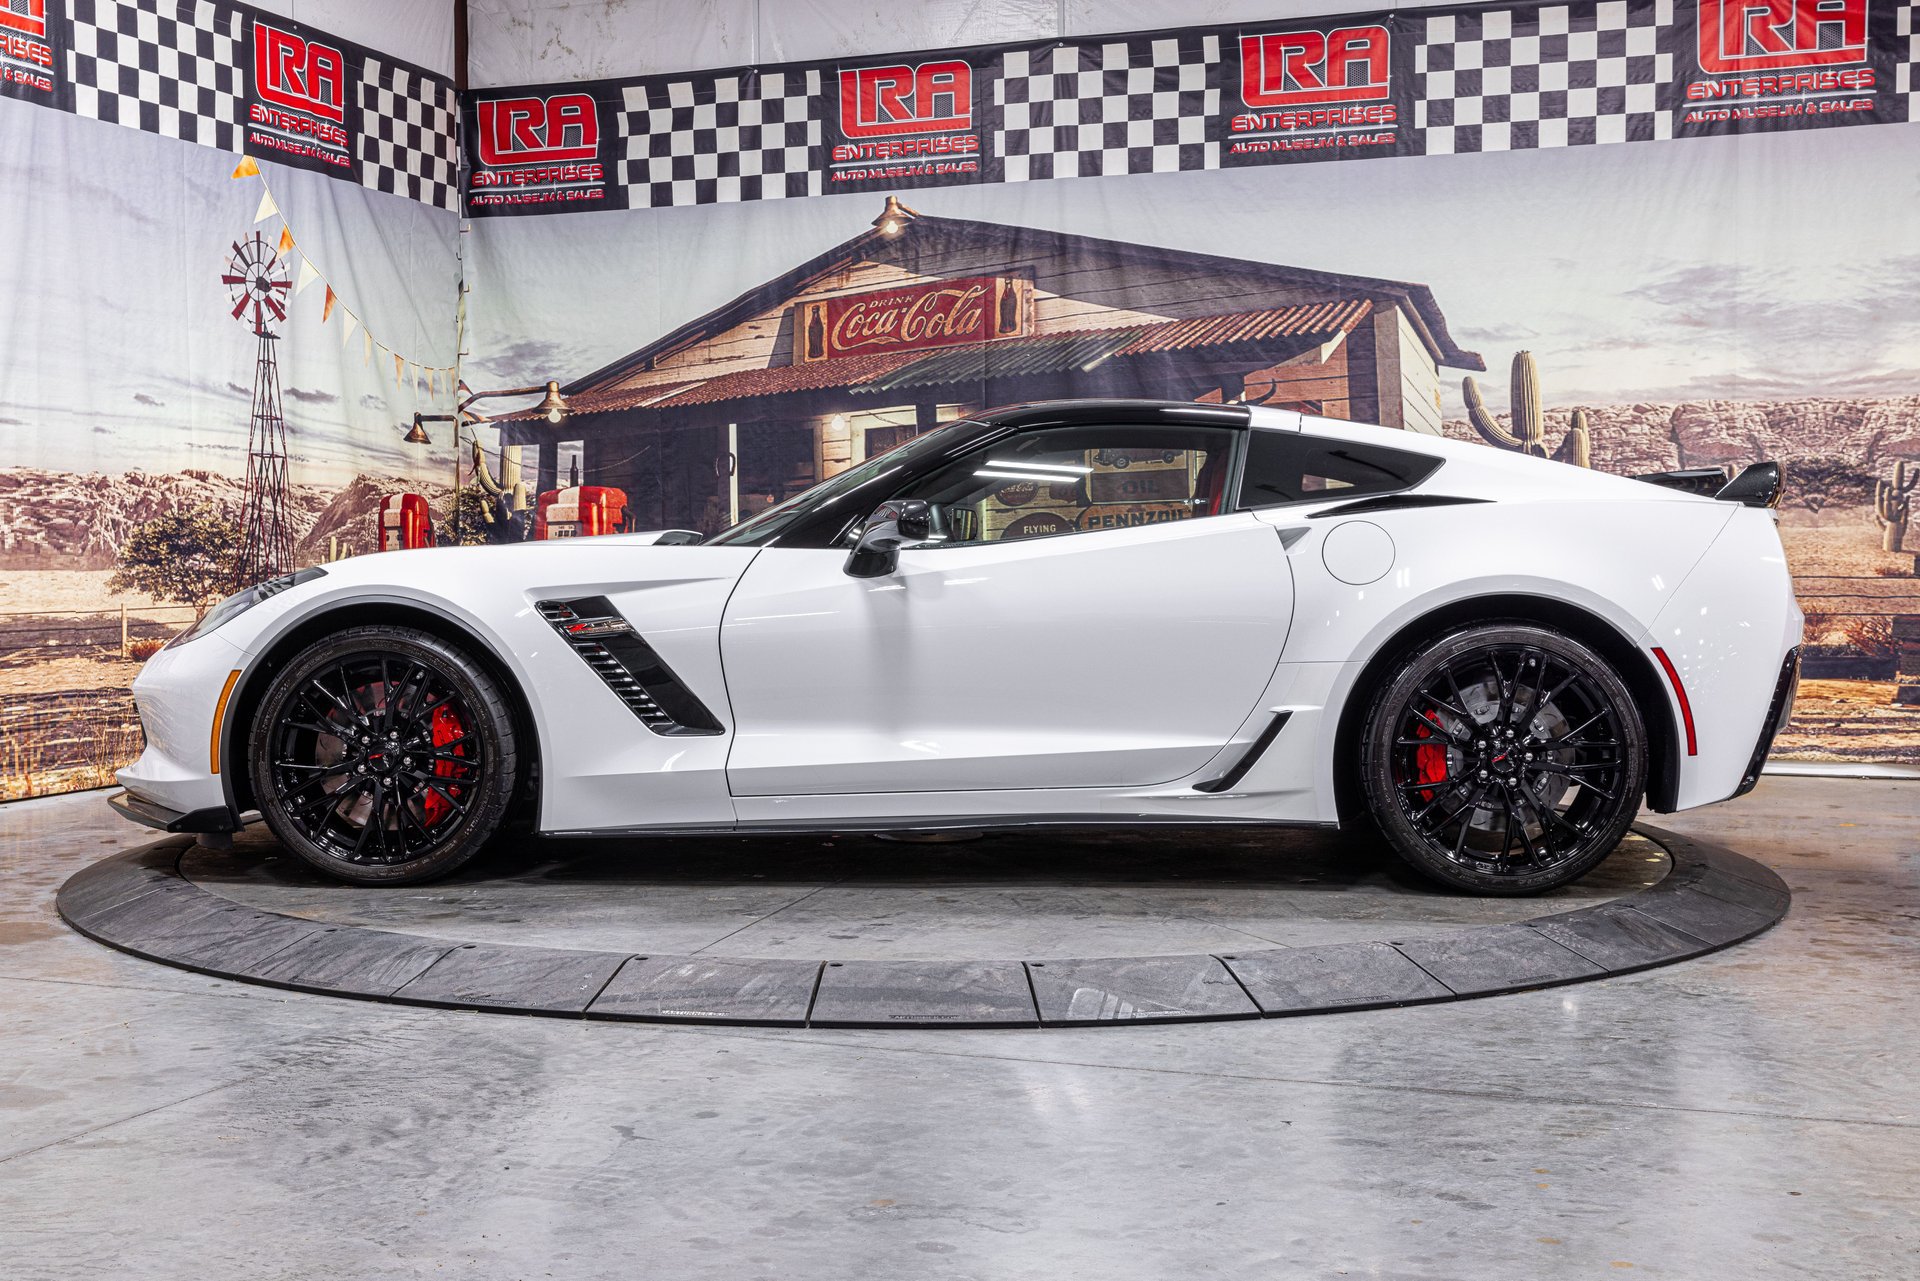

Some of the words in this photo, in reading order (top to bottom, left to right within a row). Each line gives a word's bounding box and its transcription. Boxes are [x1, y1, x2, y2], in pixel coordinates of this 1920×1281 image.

[14, 69, 53, 92] SALES
[1686, 68, 1876, 100] ENTERPRISES
[1231, 104, 1397, 132] ENTERPRISES
[1685, 109, 1730, 124] AUTO
[1732, 104, 1803, 120] MUSEUM
[1805, 102, 1817, 115] &
[1820, 99, 1875, 114] SALES
[250, 103, 349, 147] ENTERPRISES
[250, 132, 275, 148] AUTO
[831, 134, 979, 161] ENTERPRISES
[1229, 141, 1270, 154] AUTO
[1271, 136, 1335, 152] MUSEUM
[1336, 135, 1347, 147] &
[1348, 132, 1396, 146] SALES
[471, 163, 604, 187] ENTERPRISES
[831, 168, 867, 182] AUTO
[867, 165, 924, 179] MUSEUM
[925, 163, 934, 175] &
[936, 160, 978, 175] SALES
[470, 194, 504, 206] AUTO
[504, 191, 555, 205] MUSEUM
[556, 190, 565, 201] &
[566, 188, 605, 201] SALES
[869, 295, 914, 309] DRINK
[831, 285, 991, 350] Coca-Cola
[1121, 479, 1160, 495] OIL
[1022, 524, 1057, 535] FLYING
[1087, 509, 1188, 530] PENNZOIL
